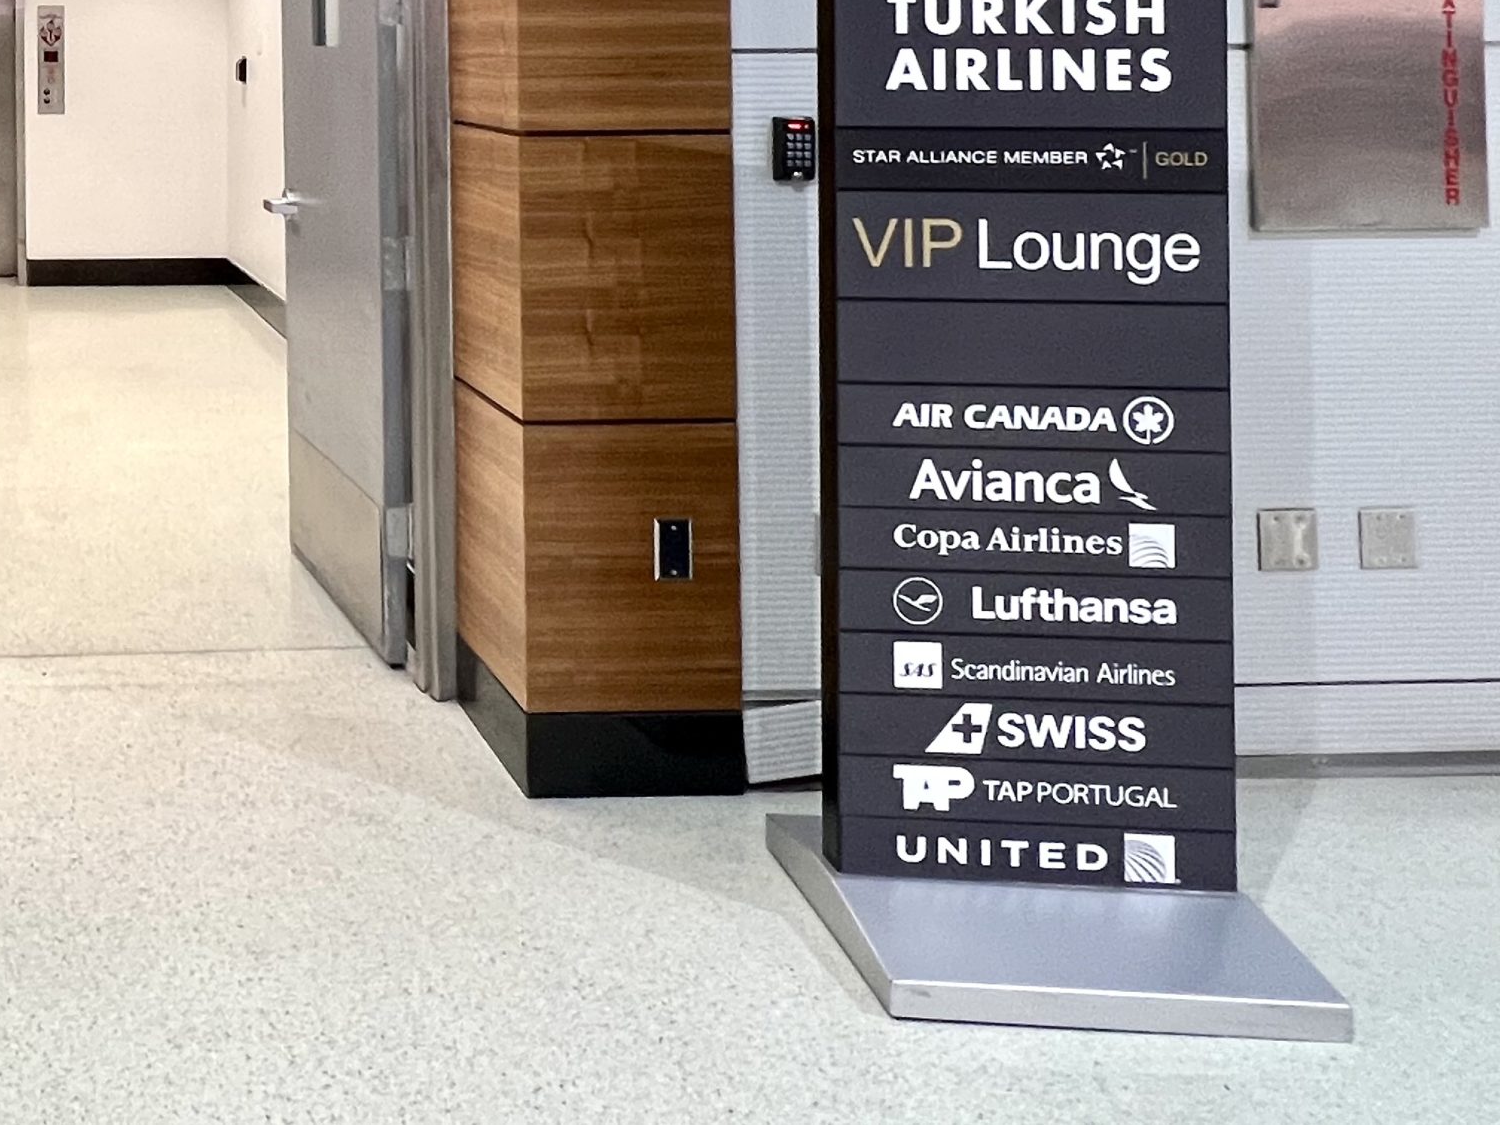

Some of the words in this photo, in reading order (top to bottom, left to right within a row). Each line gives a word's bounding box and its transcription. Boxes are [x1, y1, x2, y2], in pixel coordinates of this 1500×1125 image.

[885, 47, 1173, 93] AIRLINES
[852, 149, 902, 164] STAR
[906, 150, 998, 165] ALLIANCE
[1003, 150, 1088, 165] MEMBER
[1155, 151, 1208, 167] GOLD
[852, 217, 963, 268] VIP
[978, 218, 1201, 286] Lounge
[892, 402, 954, 429] AIR
[963, 404, 1118, 432] CANADA
[908, 458, 1101, 505] Avianca
[893, 523, 981, 556] Copa
[985, 526, 1123, 555] Airlines
[971, 585, 1177, 625] Lufthansa
[899, 662, 937, 677] SAS
[950, 657, 1090, 684] Scandinavian
[1096, 662, 1176, 687] Airlines
[997, 712, 1147, 753] SWISS
[892, 763, 976, 812] TAP
[896, 834, 1109, 872] UNITED
